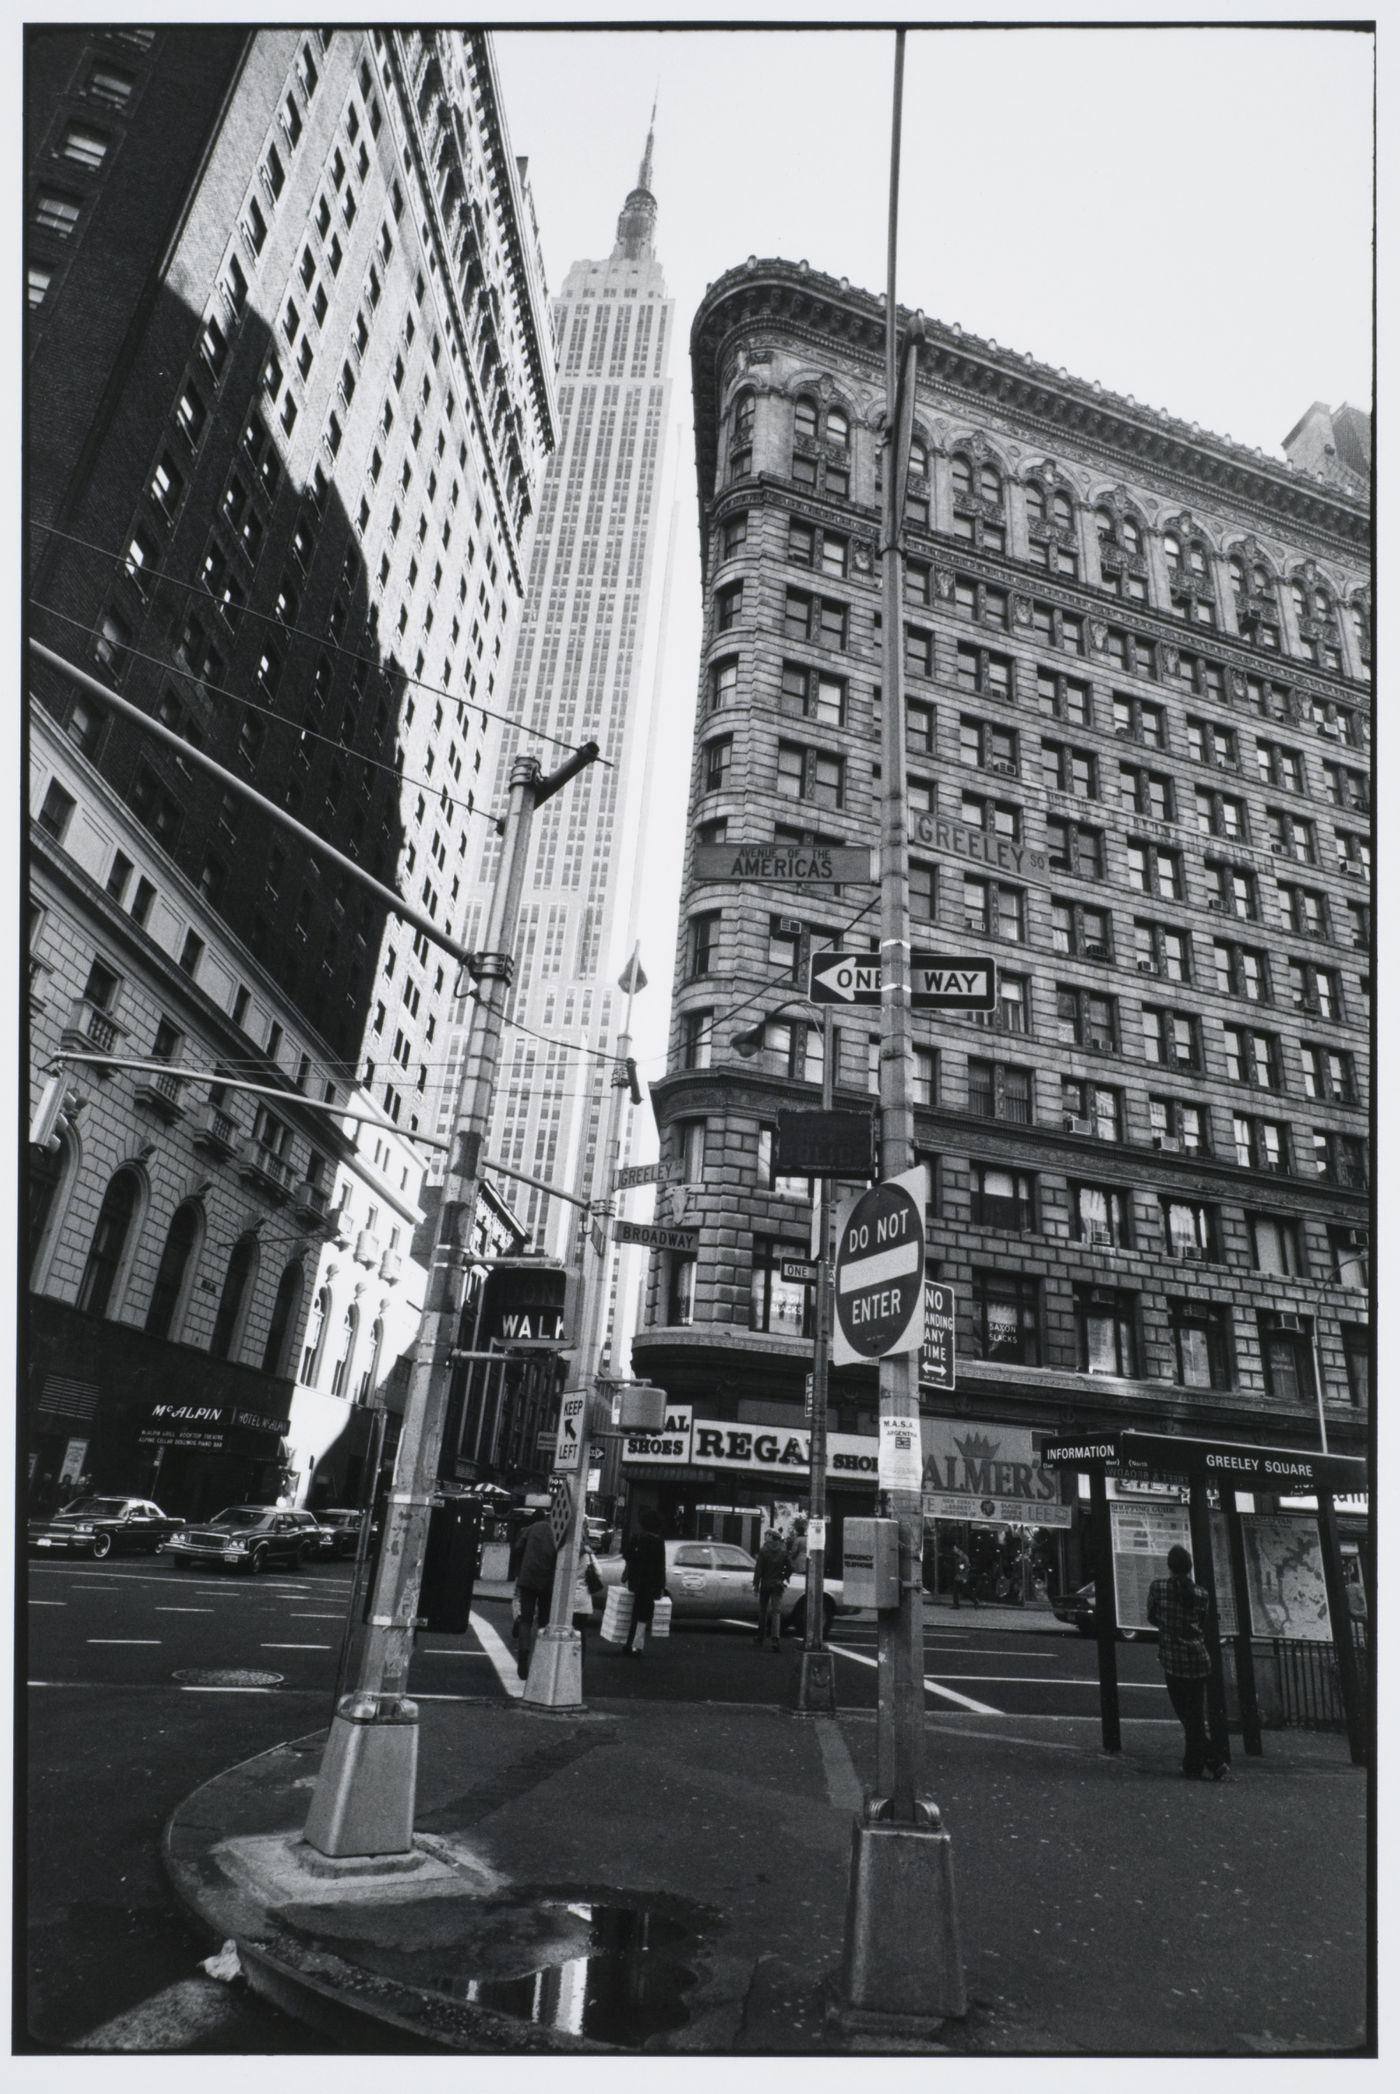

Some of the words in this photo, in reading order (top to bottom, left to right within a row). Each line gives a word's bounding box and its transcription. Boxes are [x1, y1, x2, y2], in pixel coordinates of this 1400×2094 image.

[738, 848, 778, 858] AVENUE
[787, 849, 800, 858] OF
[812, 849, 832, 860] THE
[919, 816, 1024, 873] GREELEY
[1030, 854, 1045, 870] SQ
[731, 858, 833, 879] AMERICAS
[924, 971, 979, 993] WAY
[621, 1163, 672, 1187] GREELEY
[623, 1226, 693, 1248] BROADWAY
[849, 1224, 869, 1253] DO
[877, 1208, 909, 1243] NOT
[787, 1265, 809, 1278] ONE
[852, 1288, 901, 1325] ENTER
[925, 1287, 943, 1311] NO
[502, 1314, 565, 1340] WALK
[925, 1311, 953, 1331] ANDING
[924, 1327, 945, 1344] ANY
[923, 1342, 947, 1361] TIME
[152, 1404, 223, 1421] McALPIN
[564, 1400, 583, 1416] KEEP
[558, 1443, 578, 1460] LEFT
[628, 1438, 684, 1456] SHOES
[696, 1428, 812, 1467] REGA
[1047, 1444, 1115, 1460] INFORMATION
[1206, 1454, 1259, 1471] GREELEY
[1264, 1460, 1313, 1477] SQUARE
[922, 1454, 1057, 1500] ALMER'S
